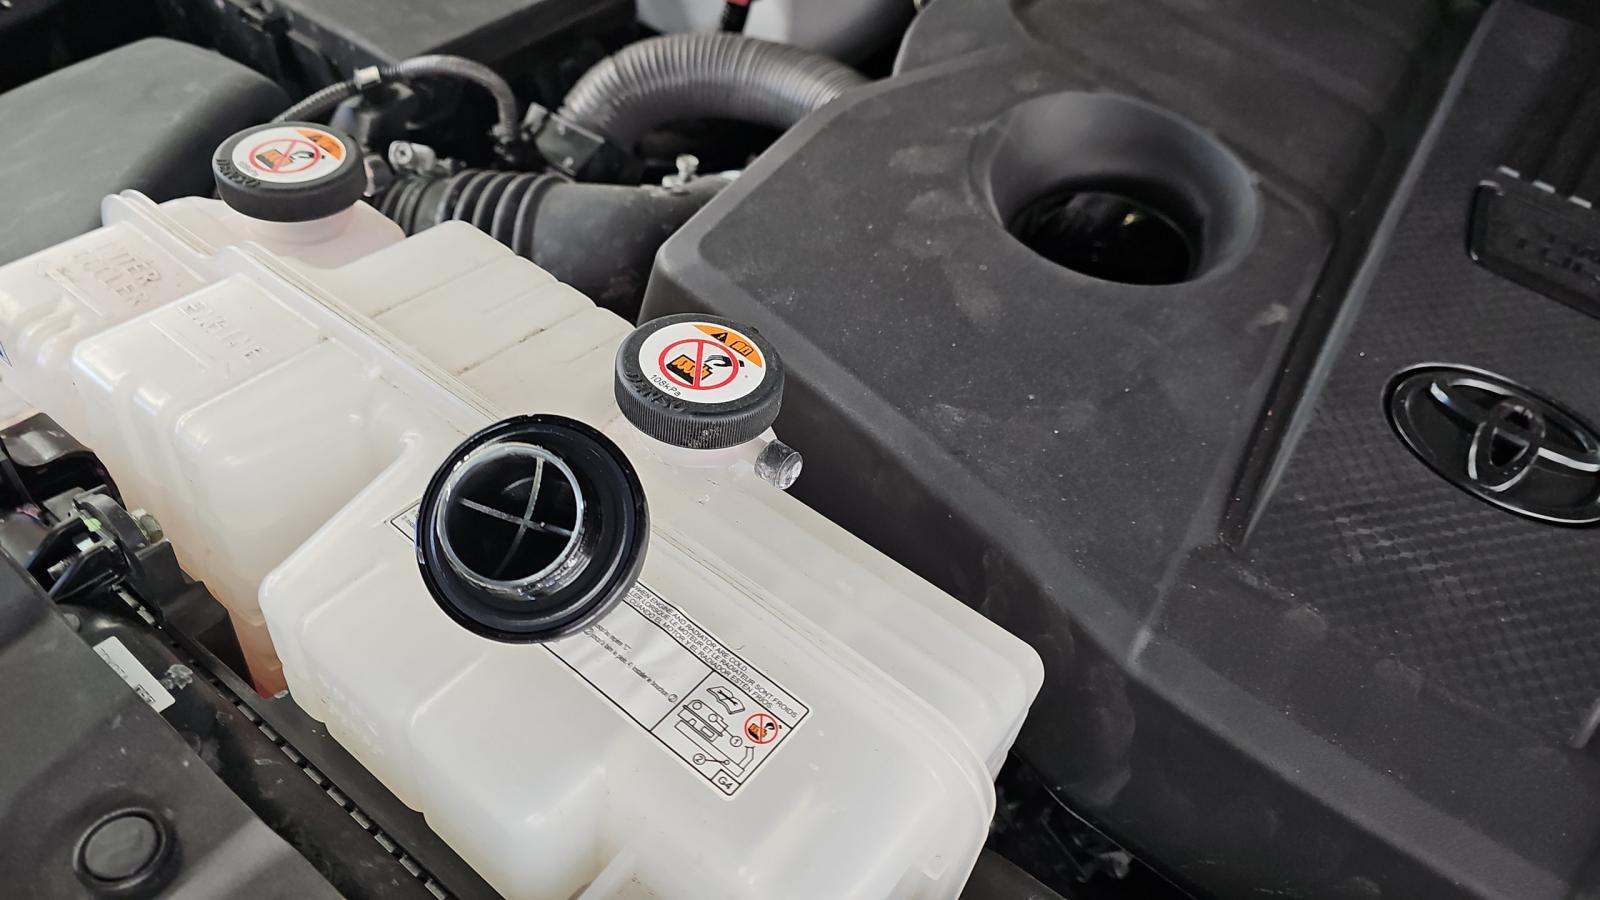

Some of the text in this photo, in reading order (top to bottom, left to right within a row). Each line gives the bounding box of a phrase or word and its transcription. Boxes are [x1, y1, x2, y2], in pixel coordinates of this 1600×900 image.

[651, 374, 681, 397] 108kPa
[671, 612, 686, 625] AND
[685, 623, 716, 649] RADIATOR
[715, 646, 730, 659] ARE
[697, 650, 731, 676] RADIADOR
[702, 645, 712, 654] ET
[710, 652, 721, 661] LE
[719, 658, 755, 686] RADIATEUR
[718, 776, 734, 789] G4
